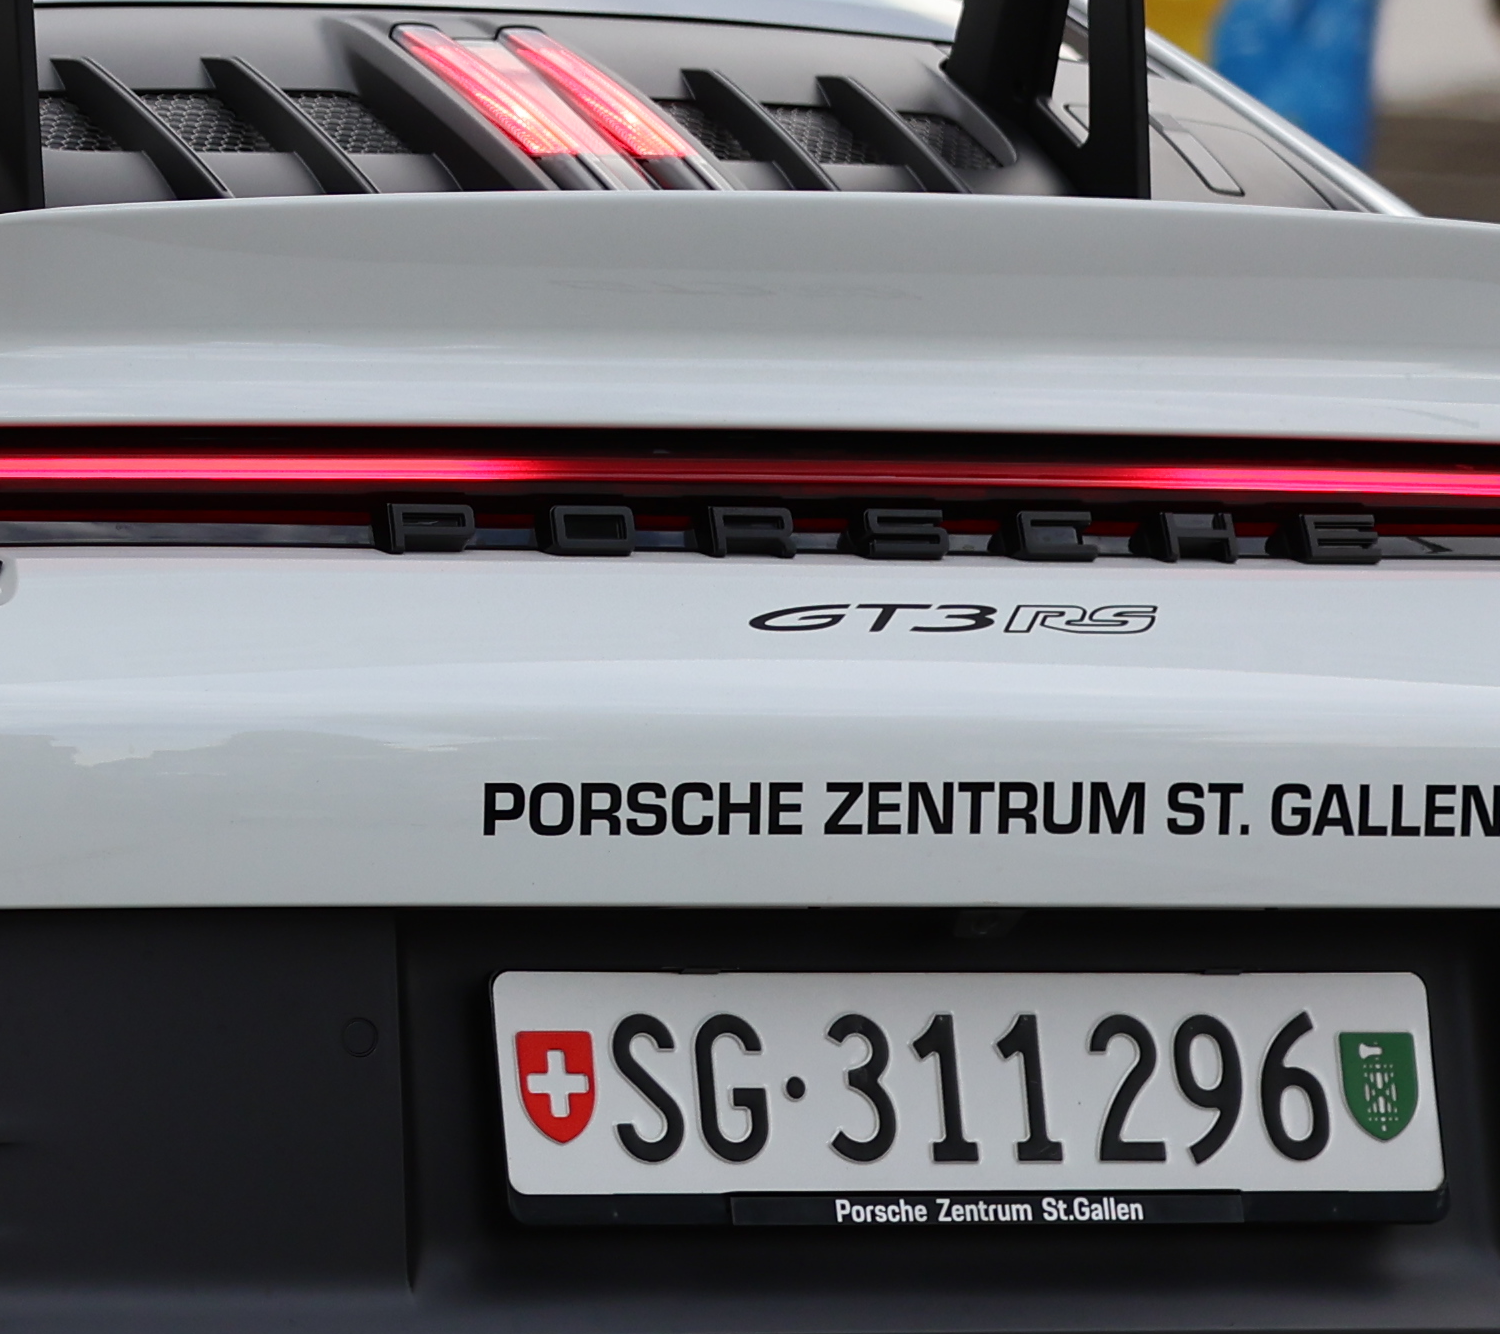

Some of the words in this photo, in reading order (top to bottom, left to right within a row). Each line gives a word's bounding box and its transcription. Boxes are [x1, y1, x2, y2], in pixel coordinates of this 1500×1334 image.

[383, 503, 1384, 564] PORSCHE
[482, 782, 804, 836] PORSCHE
[823, 781, 1147, 835] ZENTRUM
[1166, 782, 1250, 836] ST.
[1271, 782, 1500, 837] GALLEN
[835, 1198, 928, 1223] Porsche
[935, 1198, 1033, 1222] Zentrum
[1041, 1197, 1145, 1222] St.Gallen
